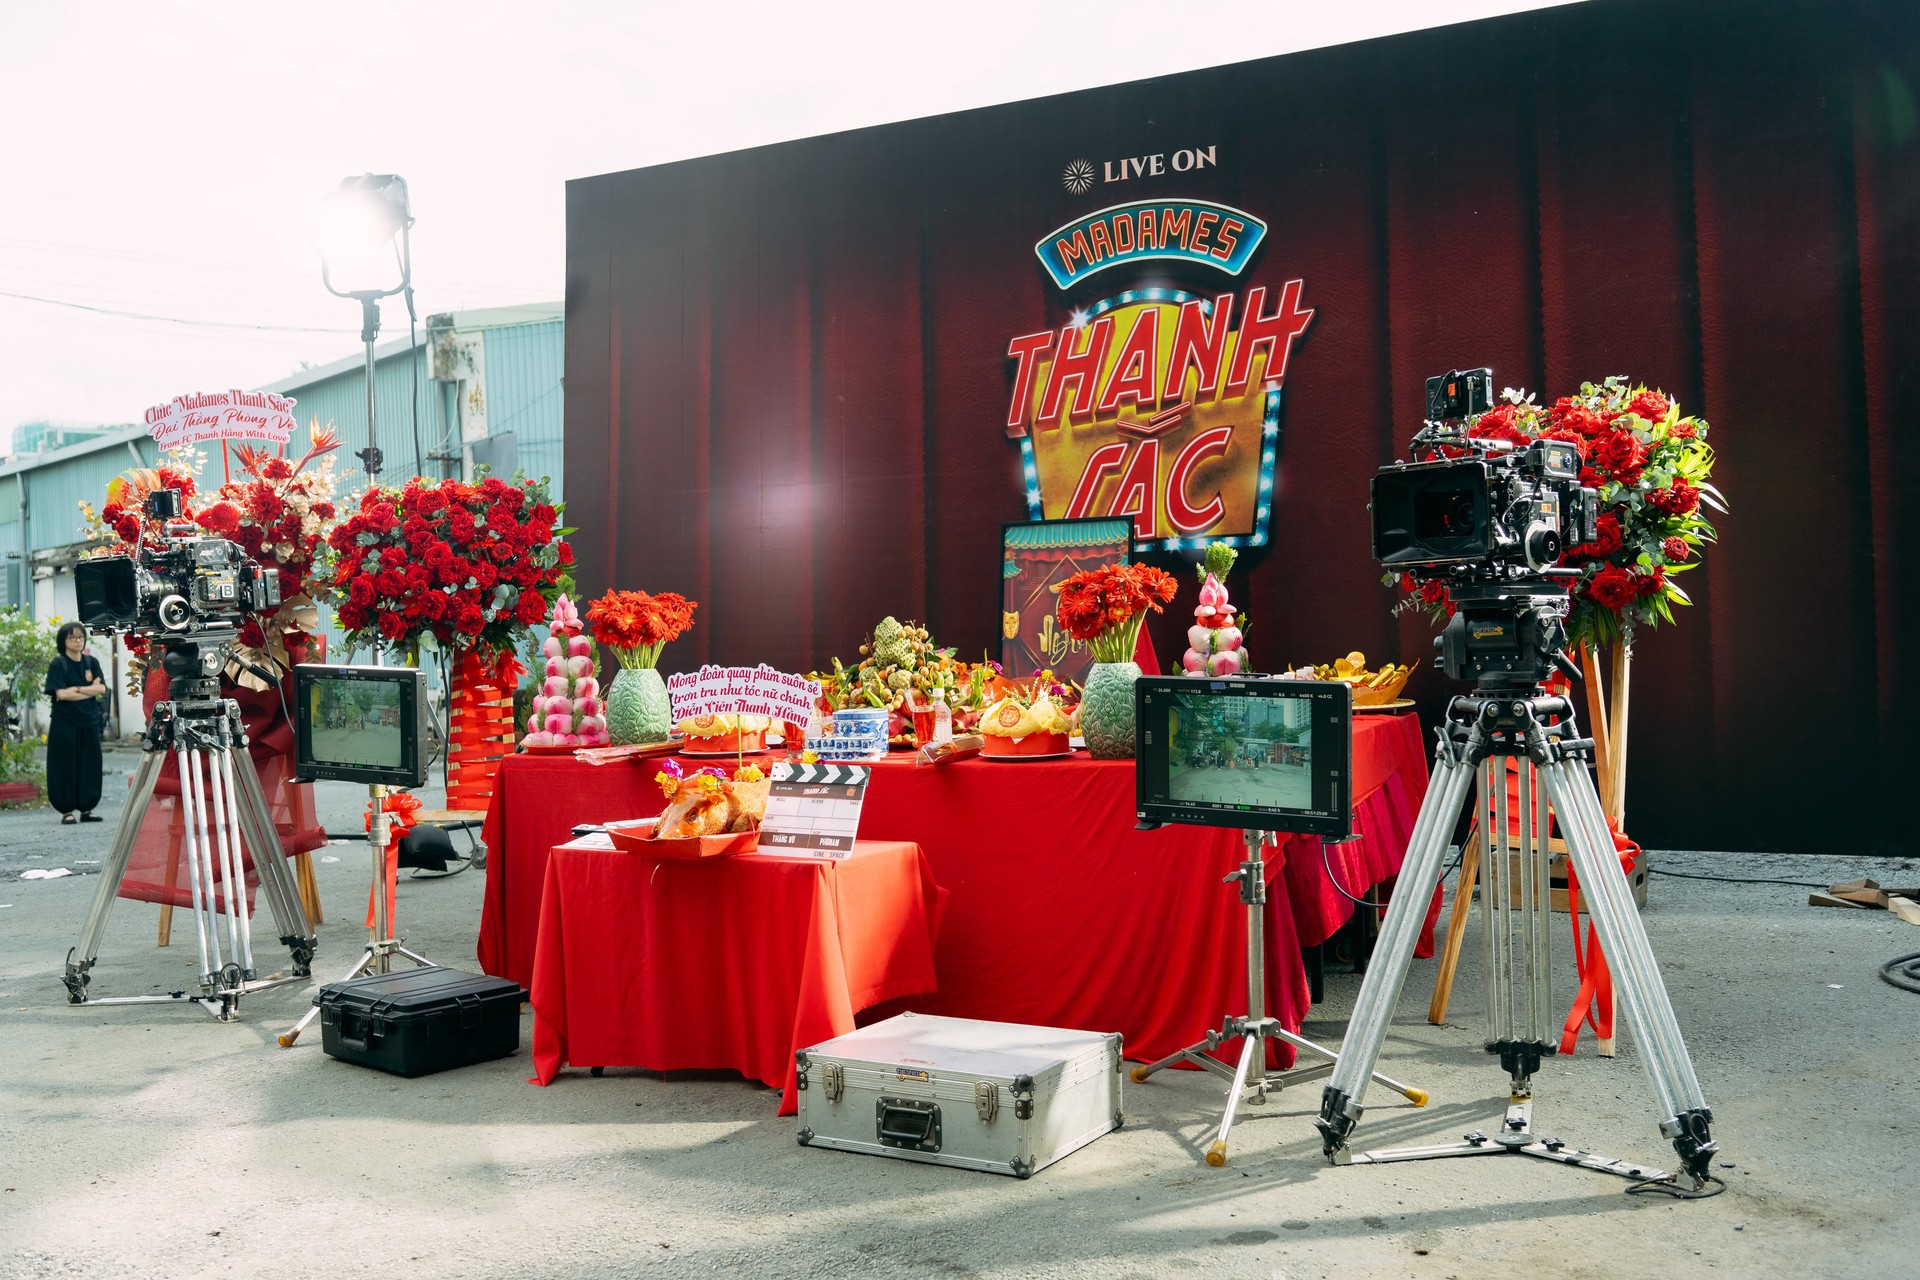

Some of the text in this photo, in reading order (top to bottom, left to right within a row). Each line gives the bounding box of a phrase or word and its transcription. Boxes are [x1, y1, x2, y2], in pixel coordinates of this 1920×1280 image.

[1103, 145, 1218, 184] LIVE ON
[1056, 207, 1244, 275] MADAMES
[1005, 278, 1315, 438] THANH
[229, 389, 267, 409] Thanh
[150, 420, 179, 440] Đại
[222, 408, 268, 430] Phòng
[182, 434, 192, 443] FC
[194, 430, 219, 441] Thanh
[245, 429, 266, 439] With
[268, 432, 288, 442] Love
[224, 585, 233, 596] B
[669, 666, 819, 696] Mong đoàn quay phim suôn sẻ
[673, 682, 812, 711] trơn tru như tóc nữ chính
[674, 699, 809, 729] Diễn Viên Thanh Hằng
